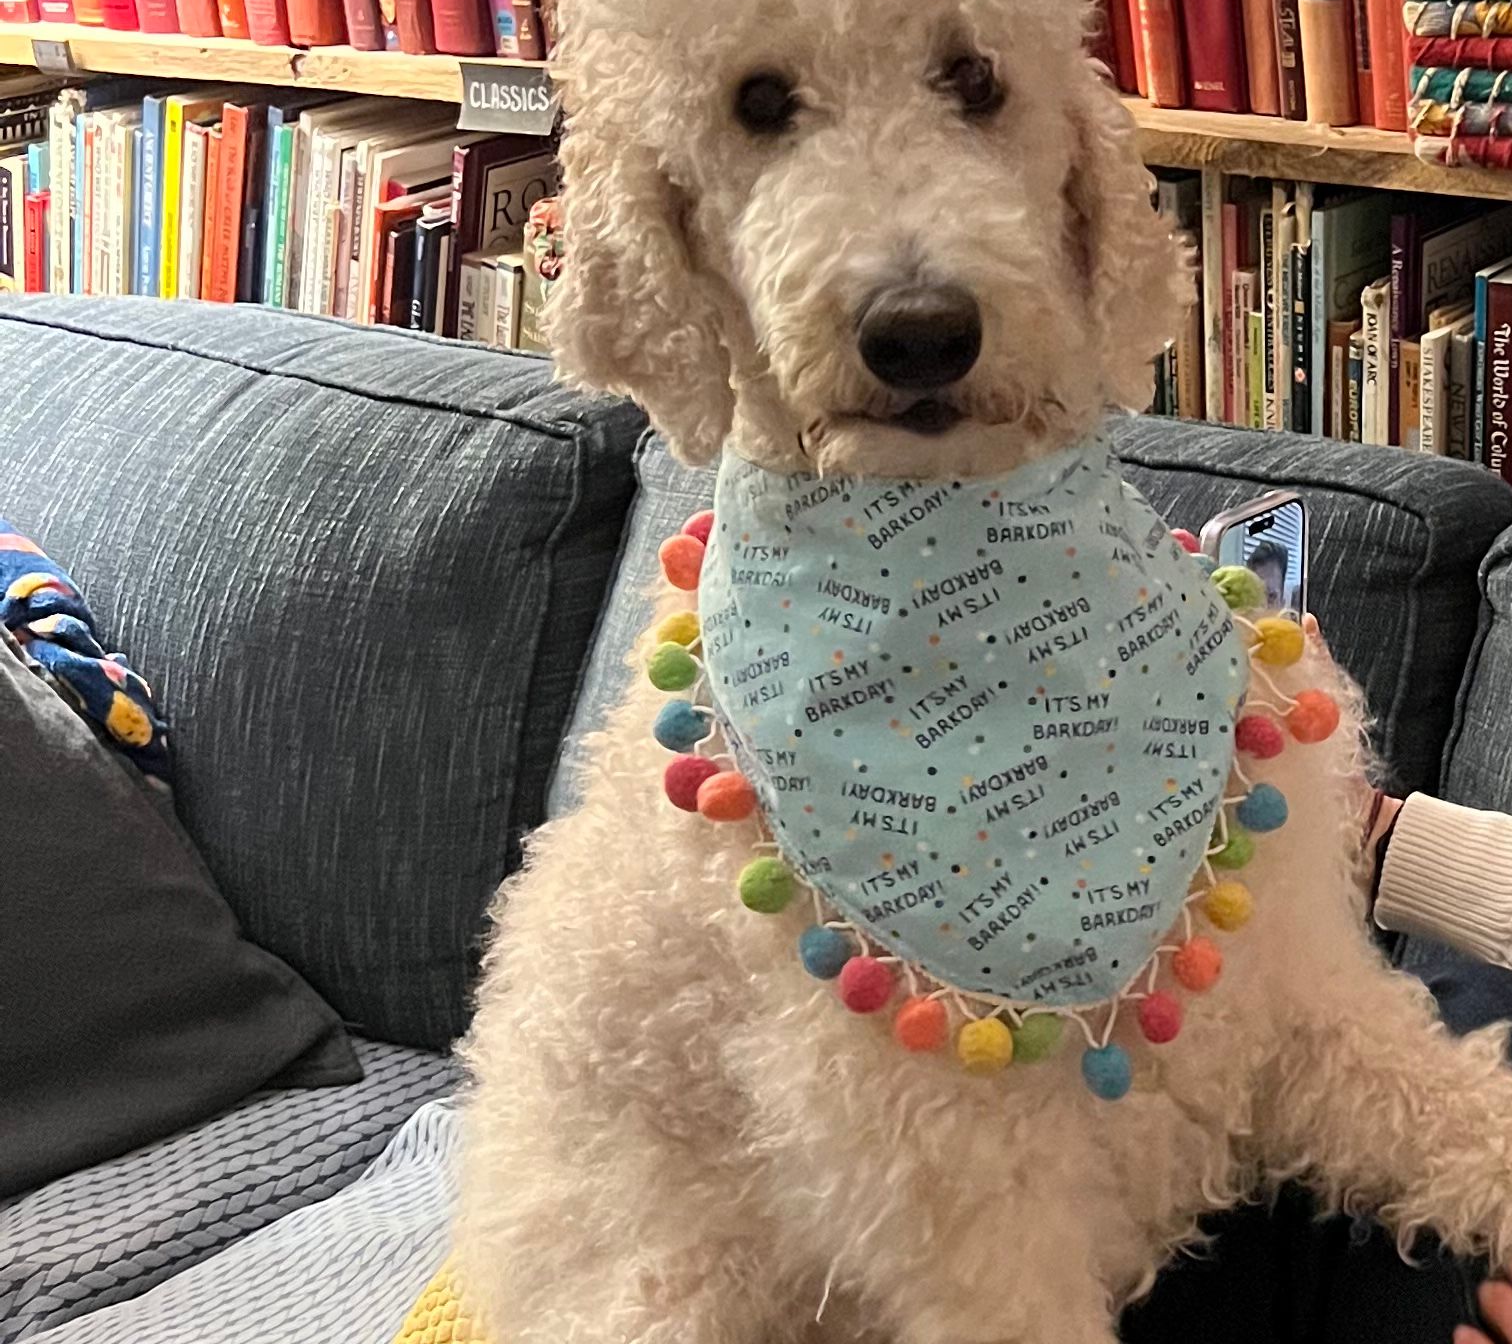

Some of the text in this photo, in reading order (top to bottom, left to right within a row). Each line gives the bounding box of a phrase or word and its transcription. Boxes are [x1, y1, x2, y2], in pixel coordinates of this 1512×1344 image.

[470, 82, 549, 112] CLASSICS
[1390, 244, 1403, 368] A Renaissance Town
[1366, 313, 1378, 386] JOAN OF ARC
[1492, 324, 1511, 429] The World of
[863, 490, 899, 520] IT'S
[868, 489, 950, 550] BARKDAY!
[986, 520, 1074, 543] BARKDAY!
[817, 581, 890, 614] BARKDAY!
[911, 558, 1005, 611] BARKDAY!
[818, 607, 840, 620] MY
[1006, 597, 1091, 646] BARKDAY!
[1118, 608, 1181, 661] BARKDAY!
[1028, 645, 1052, 664] MY
[808, 660, 869, 693] IT'S MY
[805, 679, 895, 723] BARKDAY!
[909, 675, 968, 720] IT'S MY
[1045, 693, 1110, 713] IT'S MY
[915, 687, 996, 749] BARKDAY!
[1033, 717, 1119, 740] BARKDAY!
[778, 751, 797, 766] MY
[841, 781, 937, 812] BARKDAY!
[960, 755, 1049, 805] BARKDAY!
[985, 805, 1011, 824] MY
[1044, 791, 1121, 839] BARKDAY!
[1147, 778, 1205, 822] IT'S MY
[850, 810, 918, 835] IT'S MY
[1064, 838, 1087, 857] MY
[862, 860, 920, 896] IT'S MY
[992, 871, 1013, 895] MY
[1088, 878, 1151, 904] IT'S MY
[862, 880, 943, 924] BARKDAY!
[967, 883, 1040, 951] BARKDAY!
[1080, 901, 1162, 932] BARKDAY!
